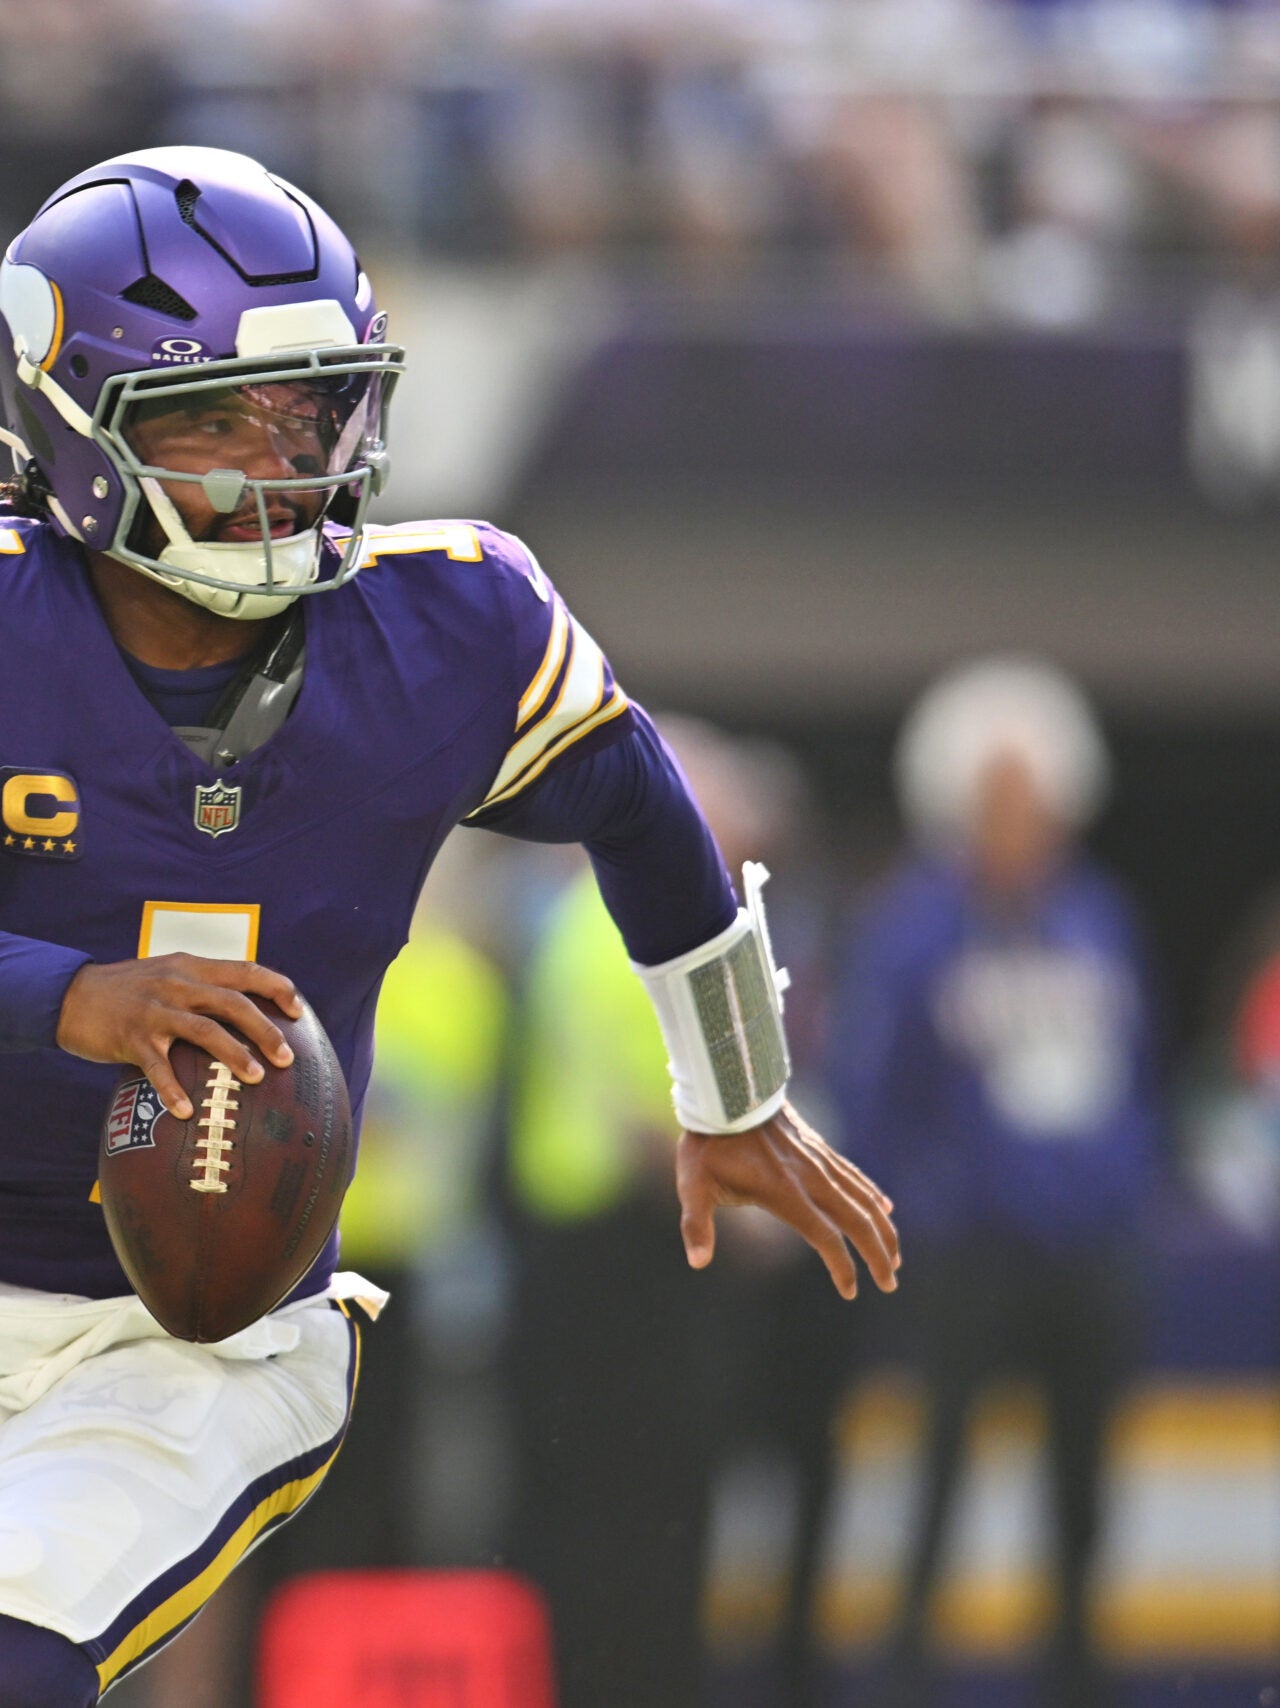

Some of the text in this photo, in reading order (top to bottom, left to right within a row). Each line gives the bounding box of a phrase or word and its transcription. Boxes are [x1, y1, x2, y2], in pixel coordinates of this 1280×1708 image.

[151, 352, 212, 364] OAKLEY
[2, 774, 79, 837] C
[201, 806, 234, 829] NFL
[109, 1086, 138, 1148] NFL
